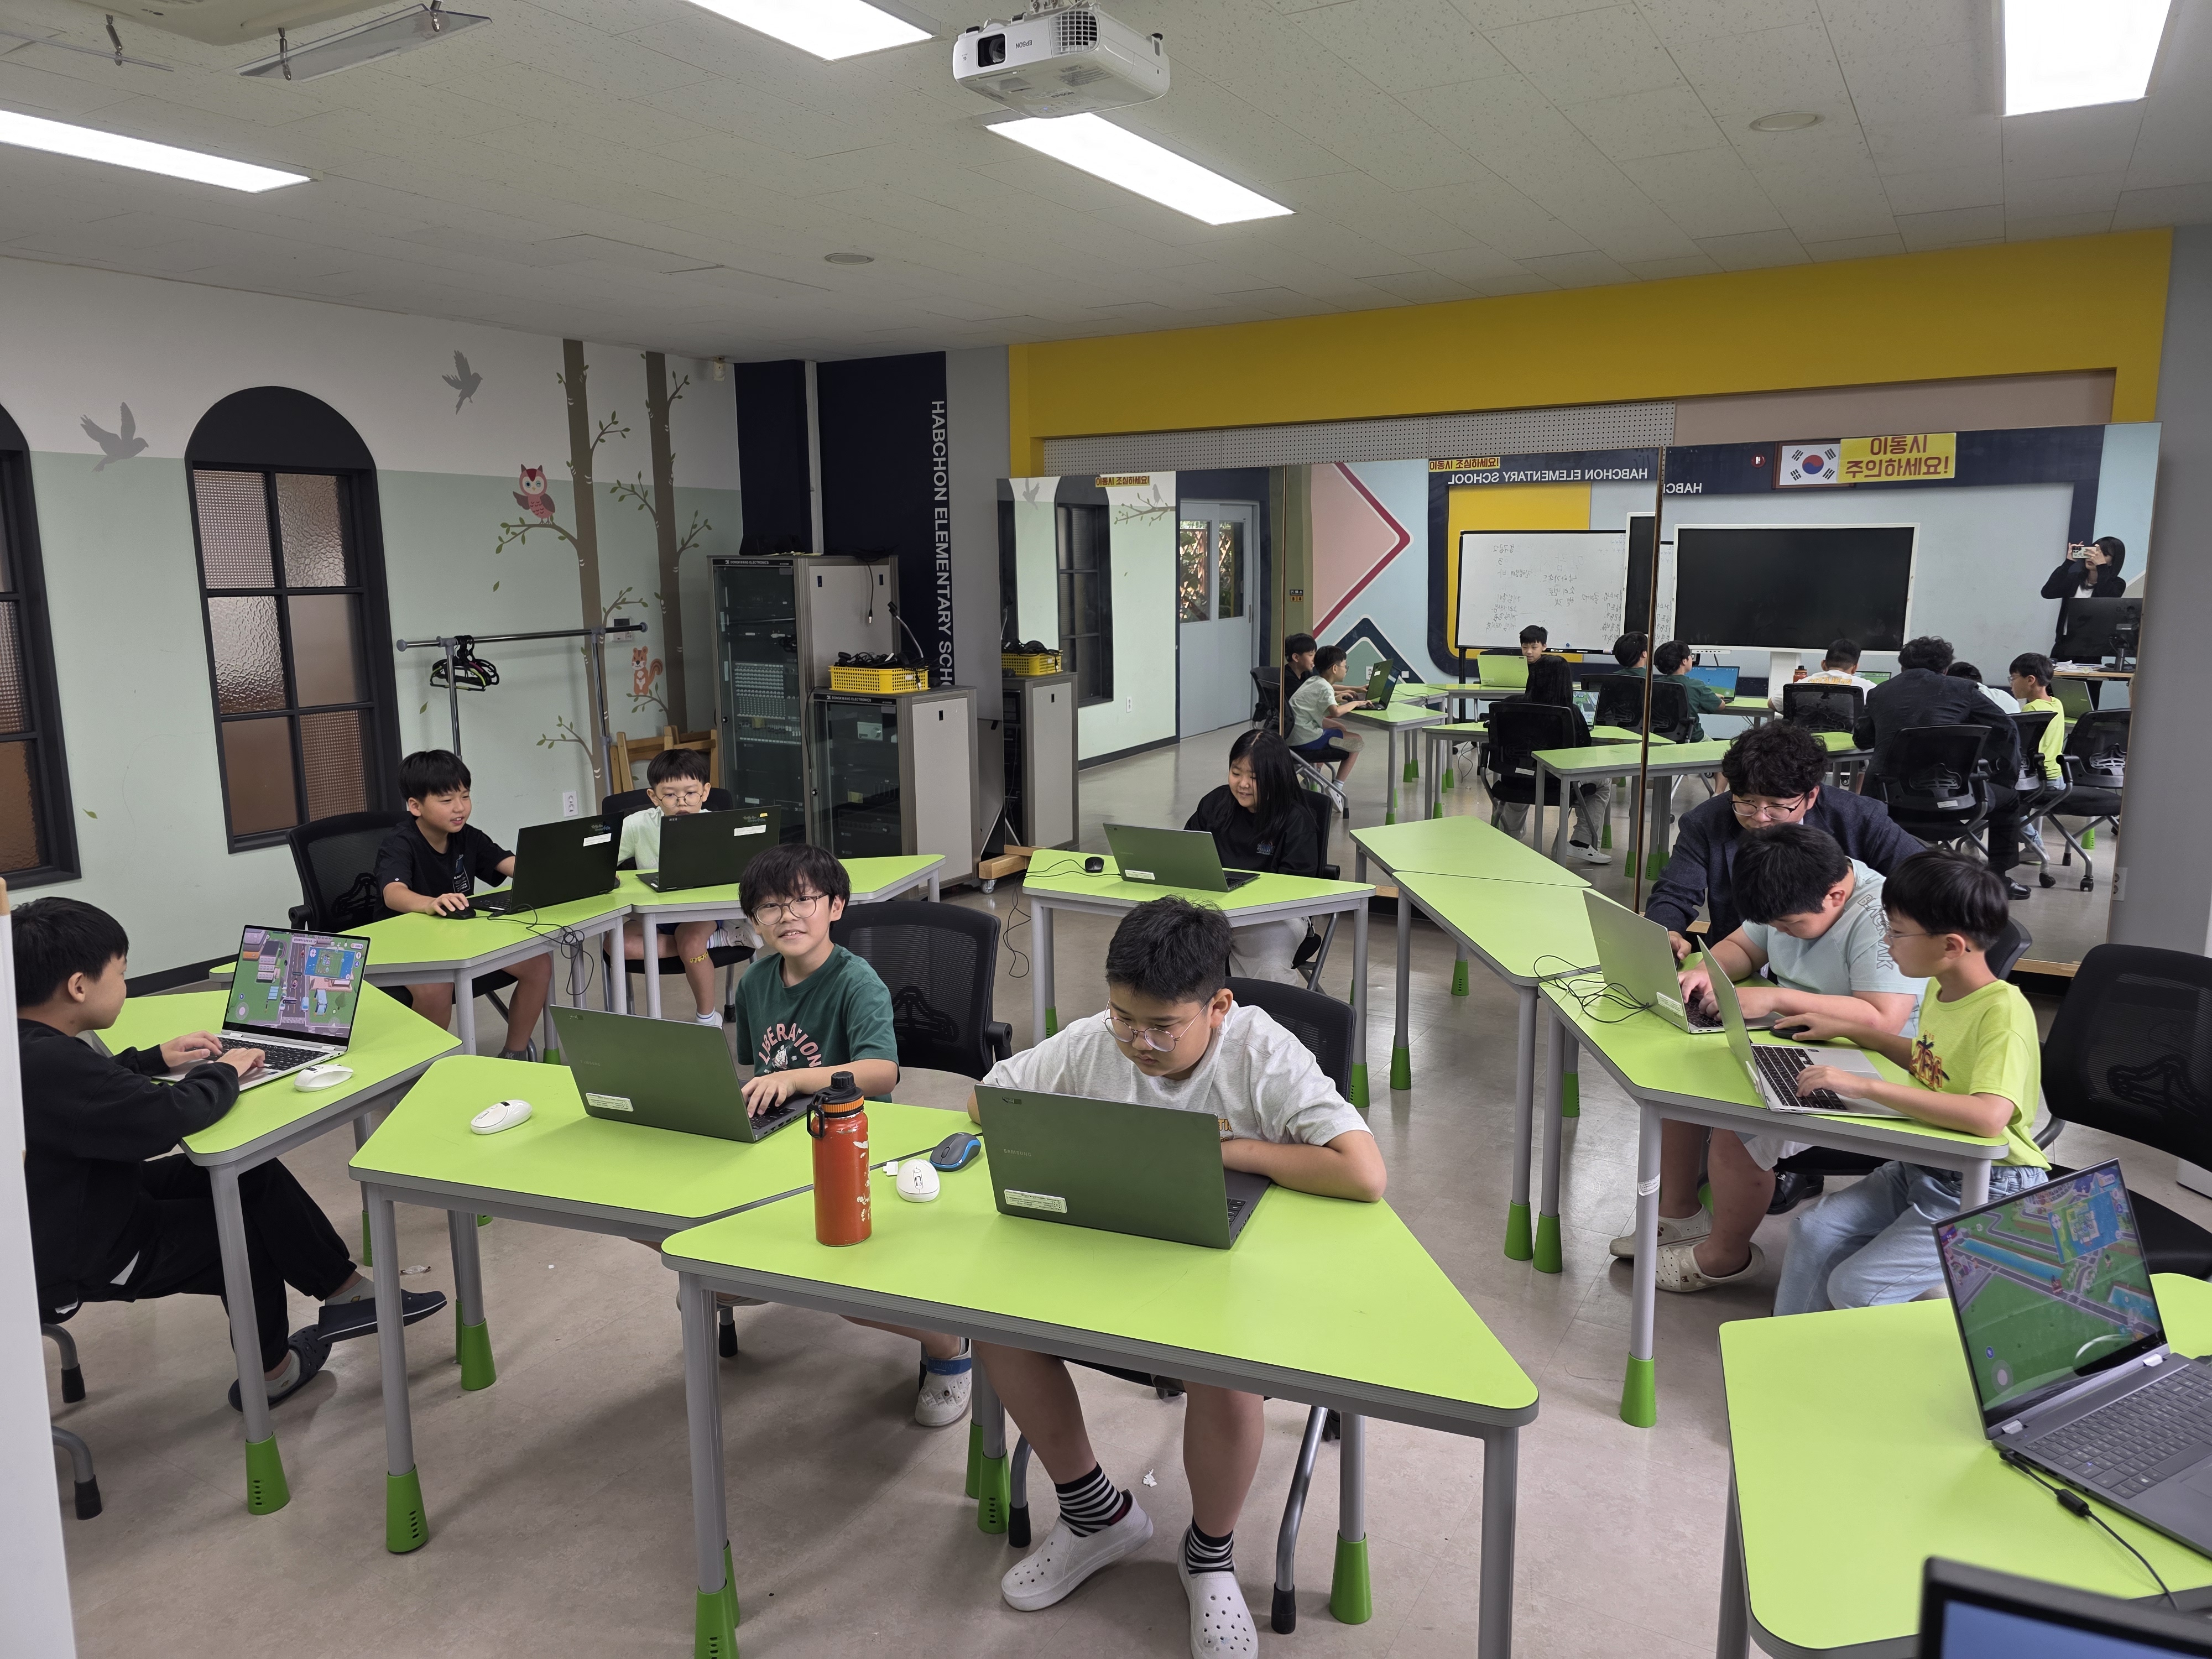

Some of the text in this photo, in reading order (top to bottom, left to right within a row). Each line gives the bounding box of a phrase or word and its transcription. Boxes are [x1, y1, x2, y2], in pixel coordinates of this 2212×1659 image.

[1015, 40, 1032, 49] EPSON
[931, 401, 947, 500] HABCHON
[1870, 435, 1928, 456] 이동시
[1429, 457, 1499, 470] 이동시 조심하세요!
[1845, 456, 1949, 479] 주의하세요!
[1096, 476, 1150, 486] 이동시 조심하세요!
[935, 507, 951, 636] ELEMENTARY
[1003, 1149, 1032, 1157] SAMSUNG
